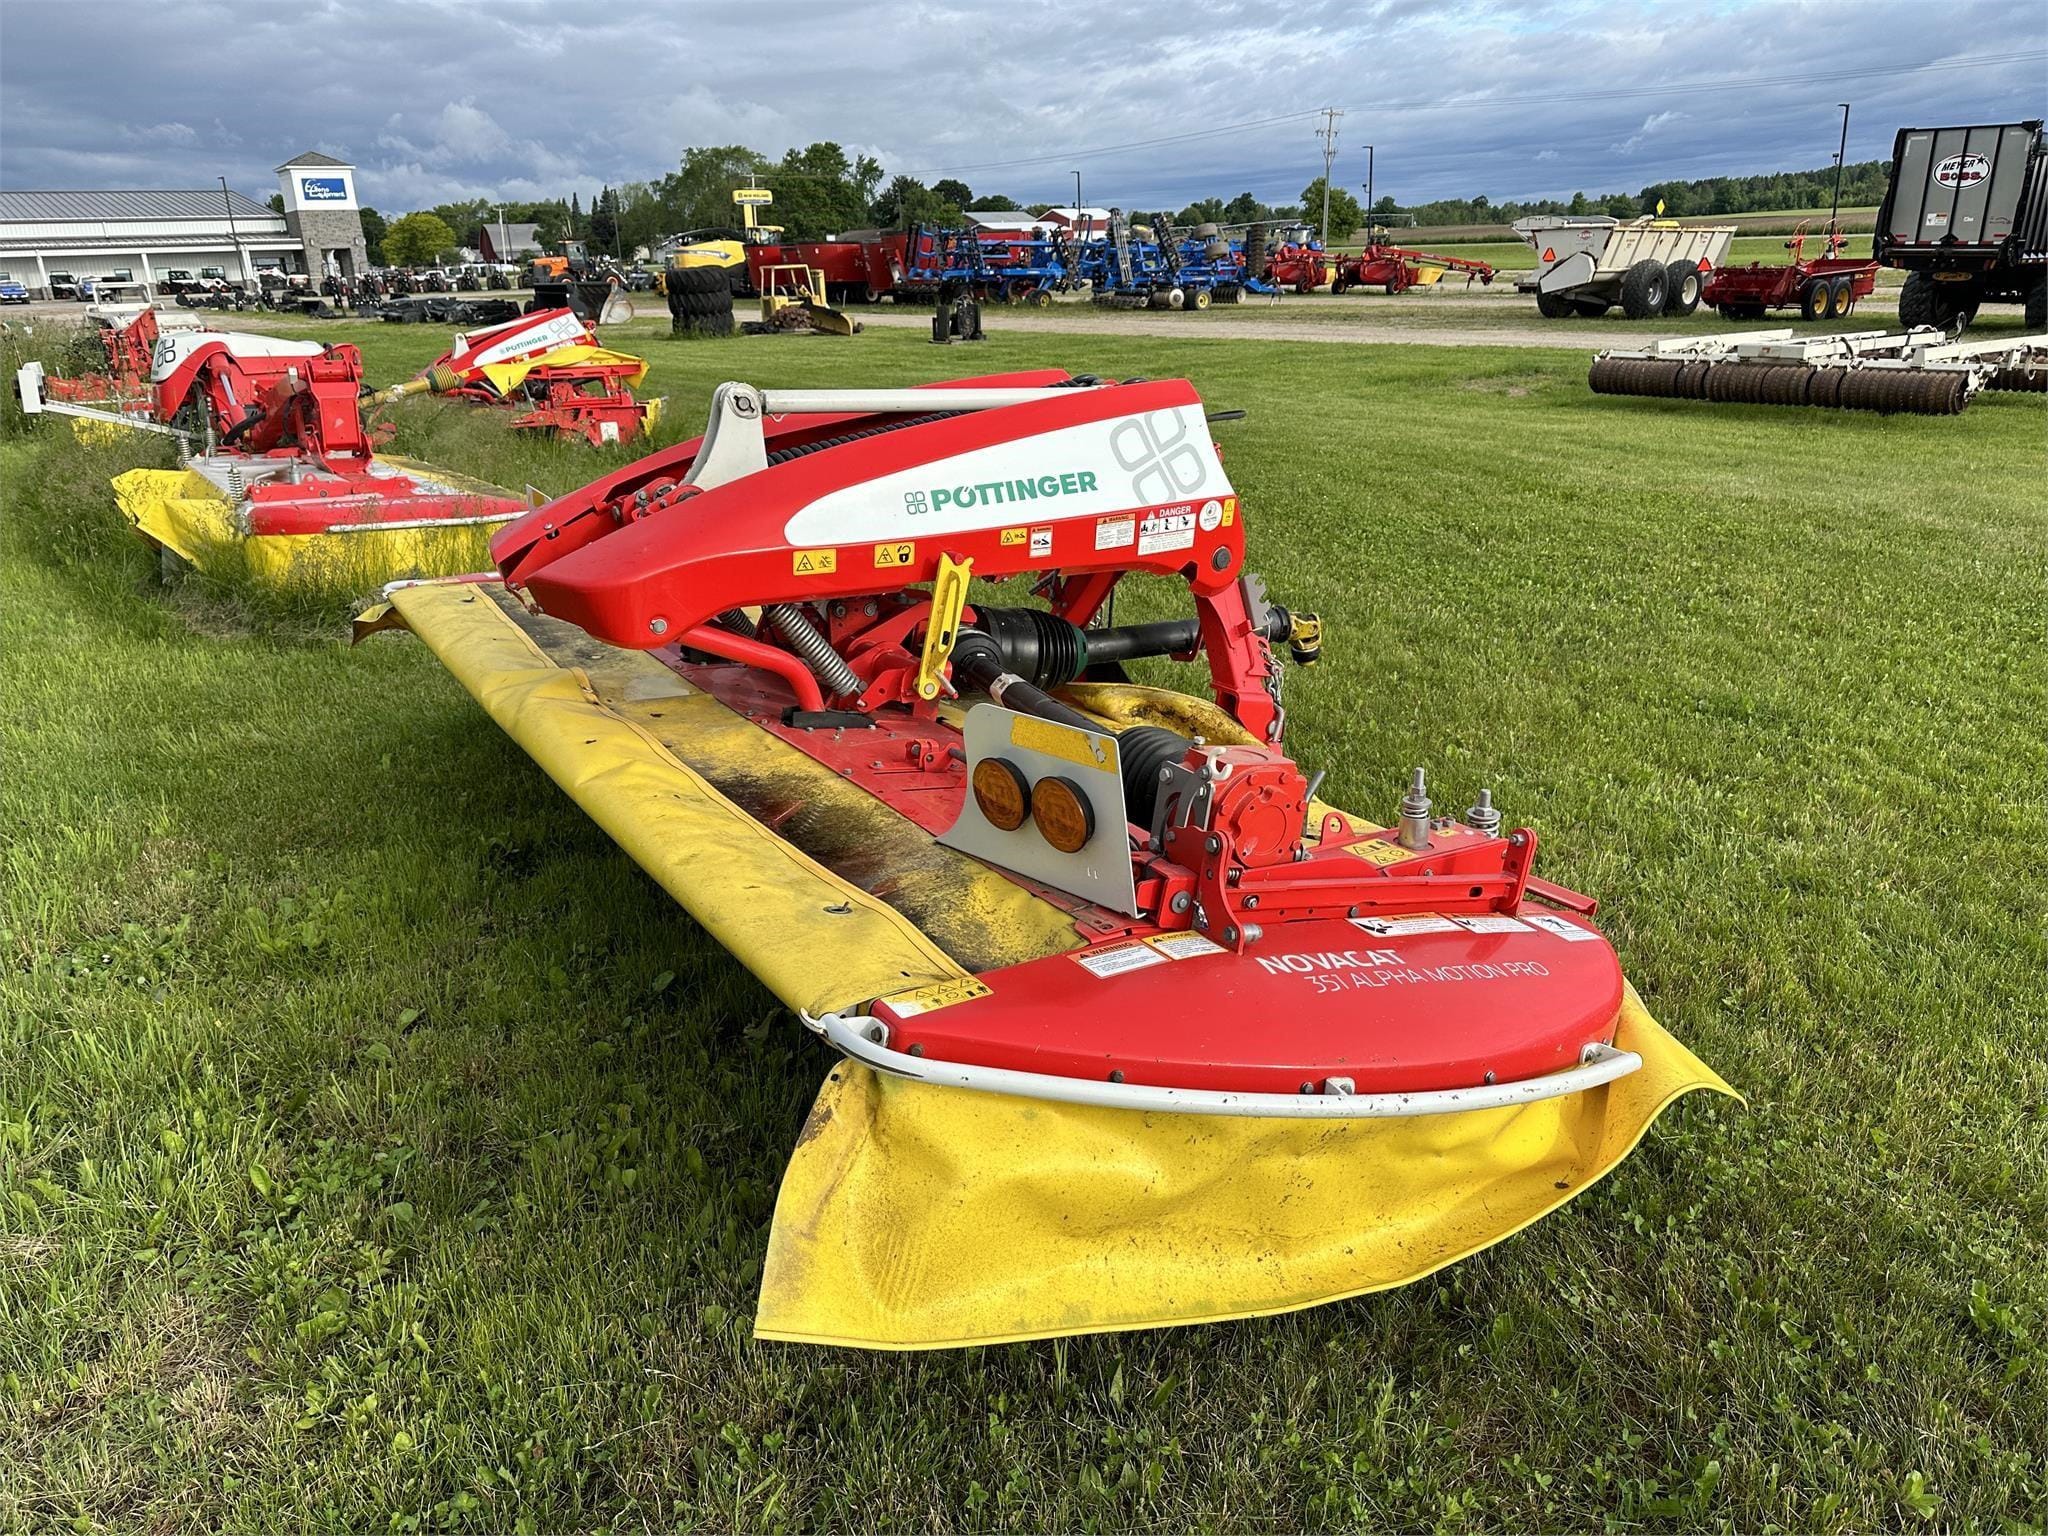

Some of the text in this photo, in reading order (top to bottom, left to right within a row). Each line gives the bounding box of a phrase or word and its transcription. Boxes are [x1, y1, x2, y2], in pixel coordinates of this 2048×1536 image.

[1941, 160, 1976, 171] MEYER
[931, 471, 1098, 512] PÖTTINGER
[1159, 505, 1192, 517] DANGER
[1089, 942, 1134, 955] WARNING
[1255, 949, 1406, 975] NOVACAT
[1304, 961, 1550, 993] 351 ALPHA MOTION PRO
